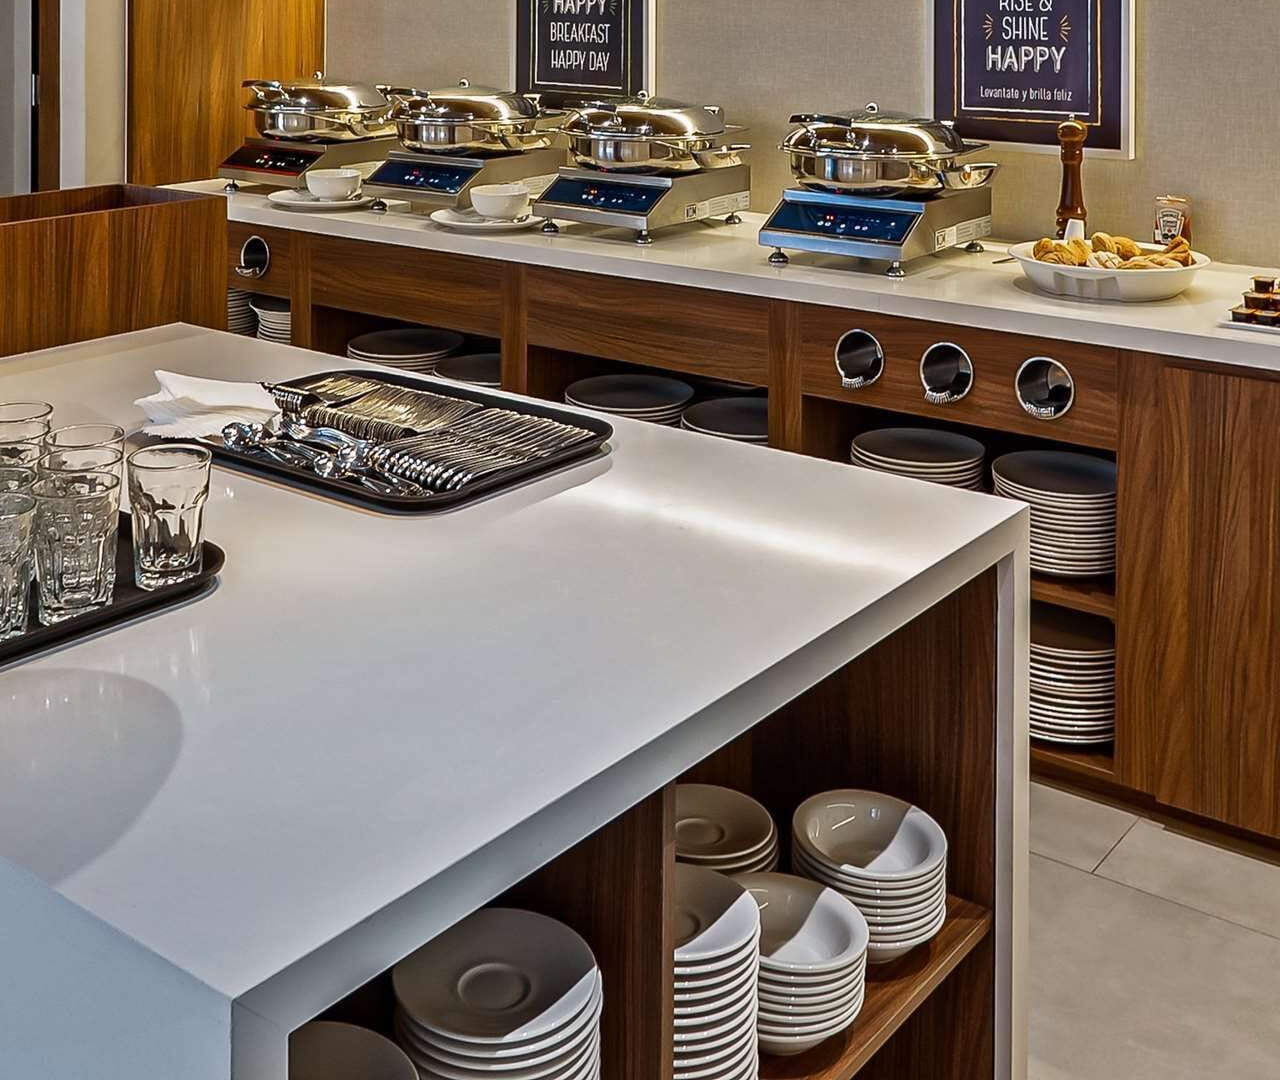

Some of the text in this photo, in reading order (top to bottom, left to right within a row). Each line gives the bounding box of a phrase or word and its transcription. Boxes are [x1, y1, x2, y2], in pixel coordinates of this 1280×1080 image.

[550, 22, 611, 44] BREAKFAST
[1001, 16, 1049, 41] SHINE
[551, 49, 610, 72] HAPPY DAY
[985, 45, 1067, 73] HAPPY
[1021, 89, 1028, 102] y
[1029, 87, 1052, 101] brilla
[1053, 88, 1073, 102] feliz
